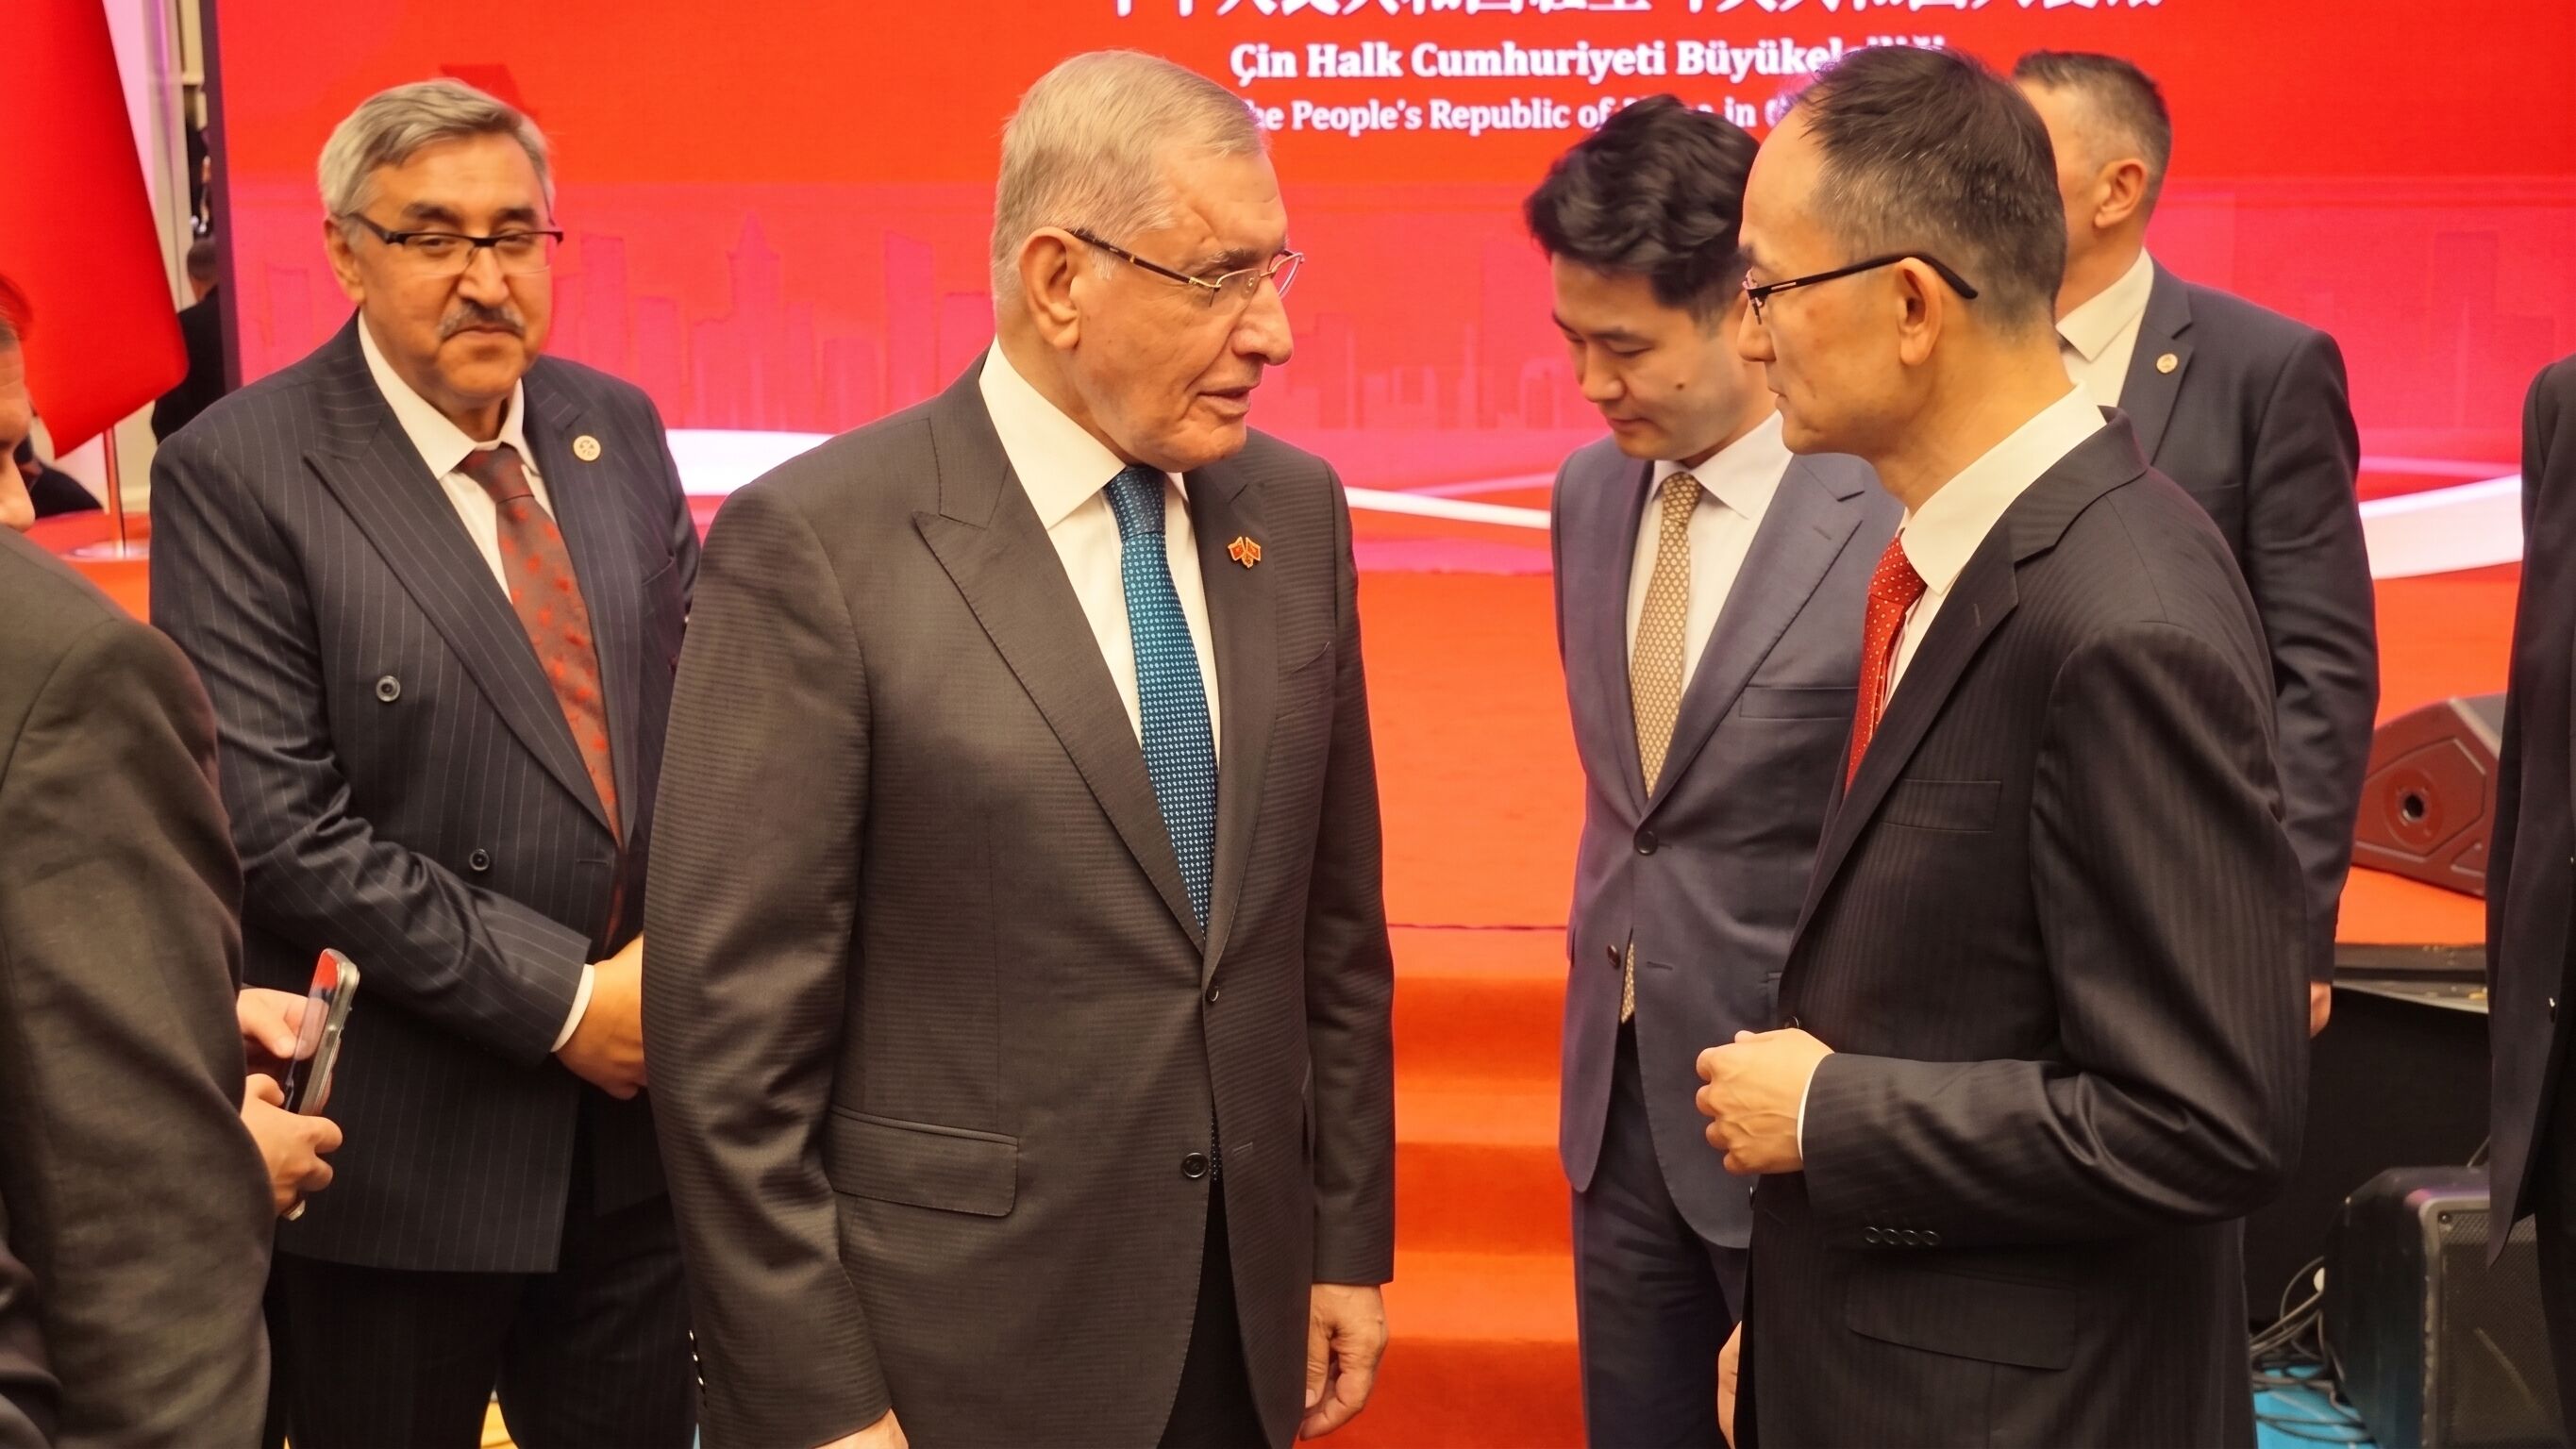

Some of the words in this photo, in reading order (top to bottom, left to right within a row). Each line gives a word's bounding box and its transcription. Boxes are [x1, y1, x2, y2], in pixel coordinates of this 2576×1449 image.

[1229, 42, 1298, 88] Çin
[1306, 41, 1404, 78] Halk
[1411, 40, 1667, 85] Cumhuriyeti
[1291, 98, 1423, 138] People's
[1429, 97, 1571, 137] Republic
[1577, 96, 1616, 131] of
[1724, 96, 1757, 128] in
